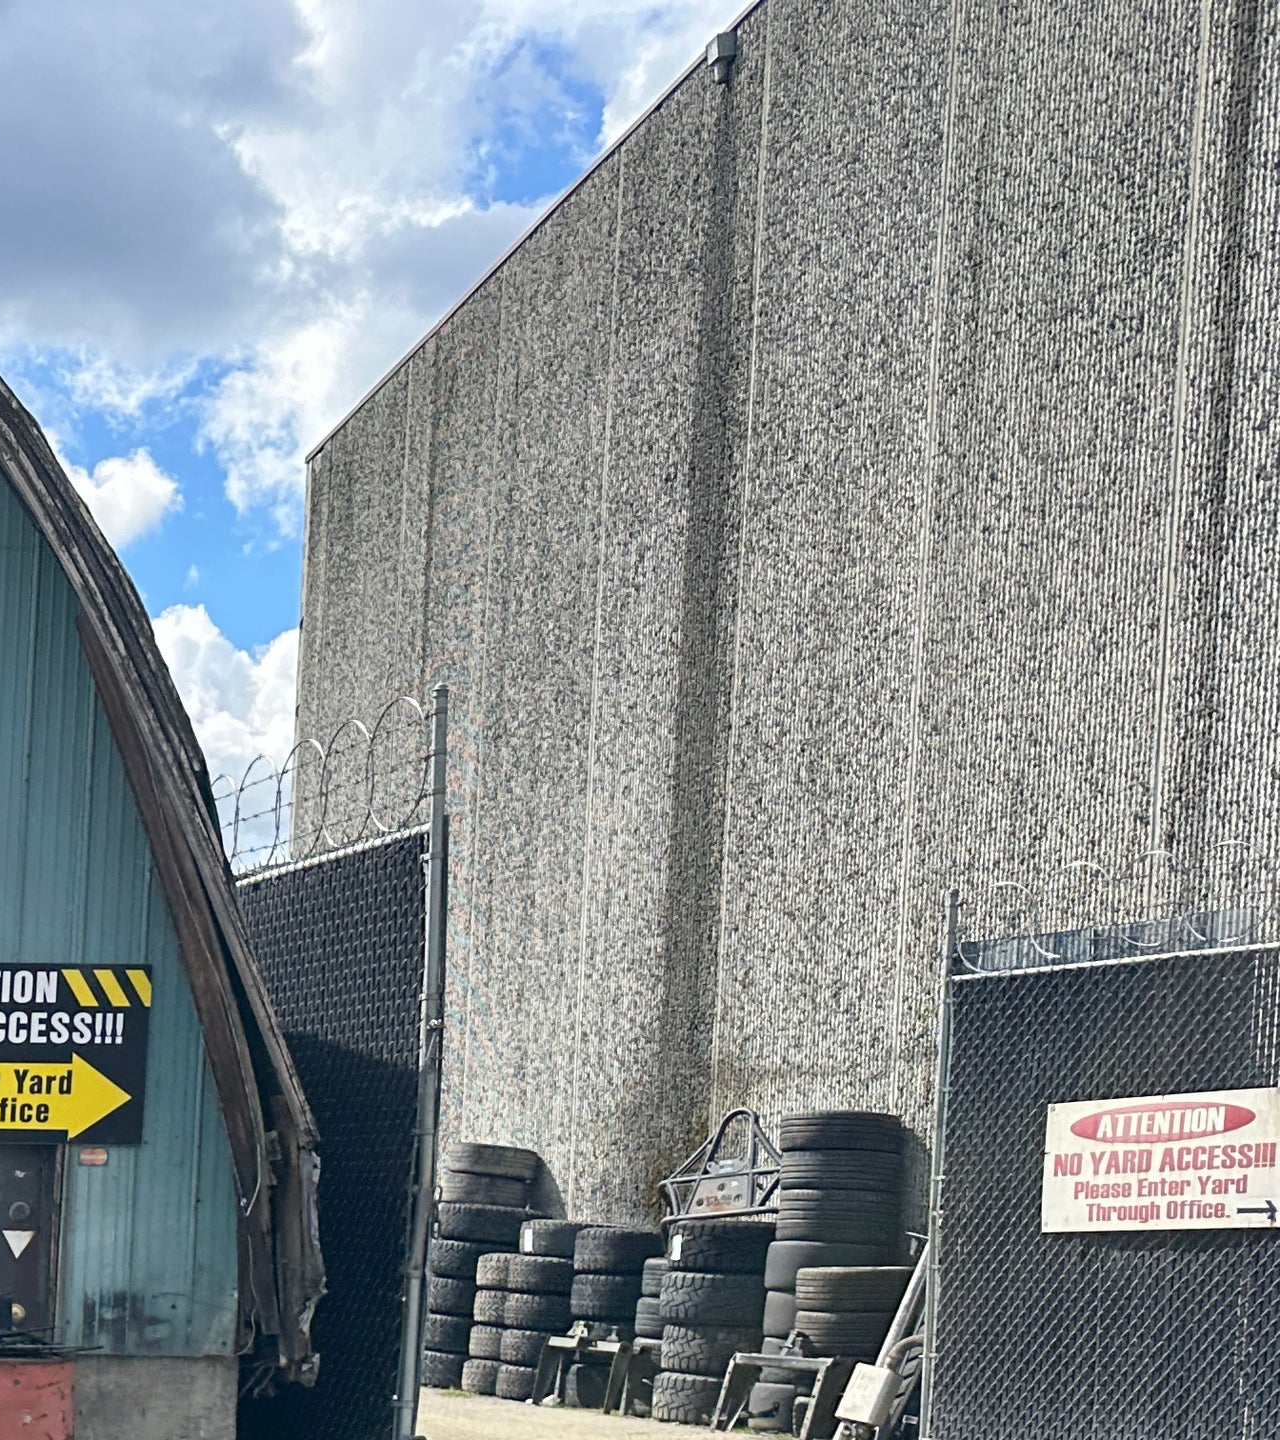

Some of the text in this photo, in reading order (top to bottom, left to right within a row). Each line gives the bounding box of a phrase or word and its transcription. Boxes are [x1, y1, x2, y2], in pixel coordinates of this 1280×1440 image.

[14, 1070, 73, 1095] Yard
[1096, 1106, 1226, 1138] ATTENTION
[1053, 1142, 1277, 1177] NO YARD ACCESS!!!
[1074, 1174, 1248, 1200] Please Enter Yard
[1086, 1200, 1231, 1223] Through Office.
